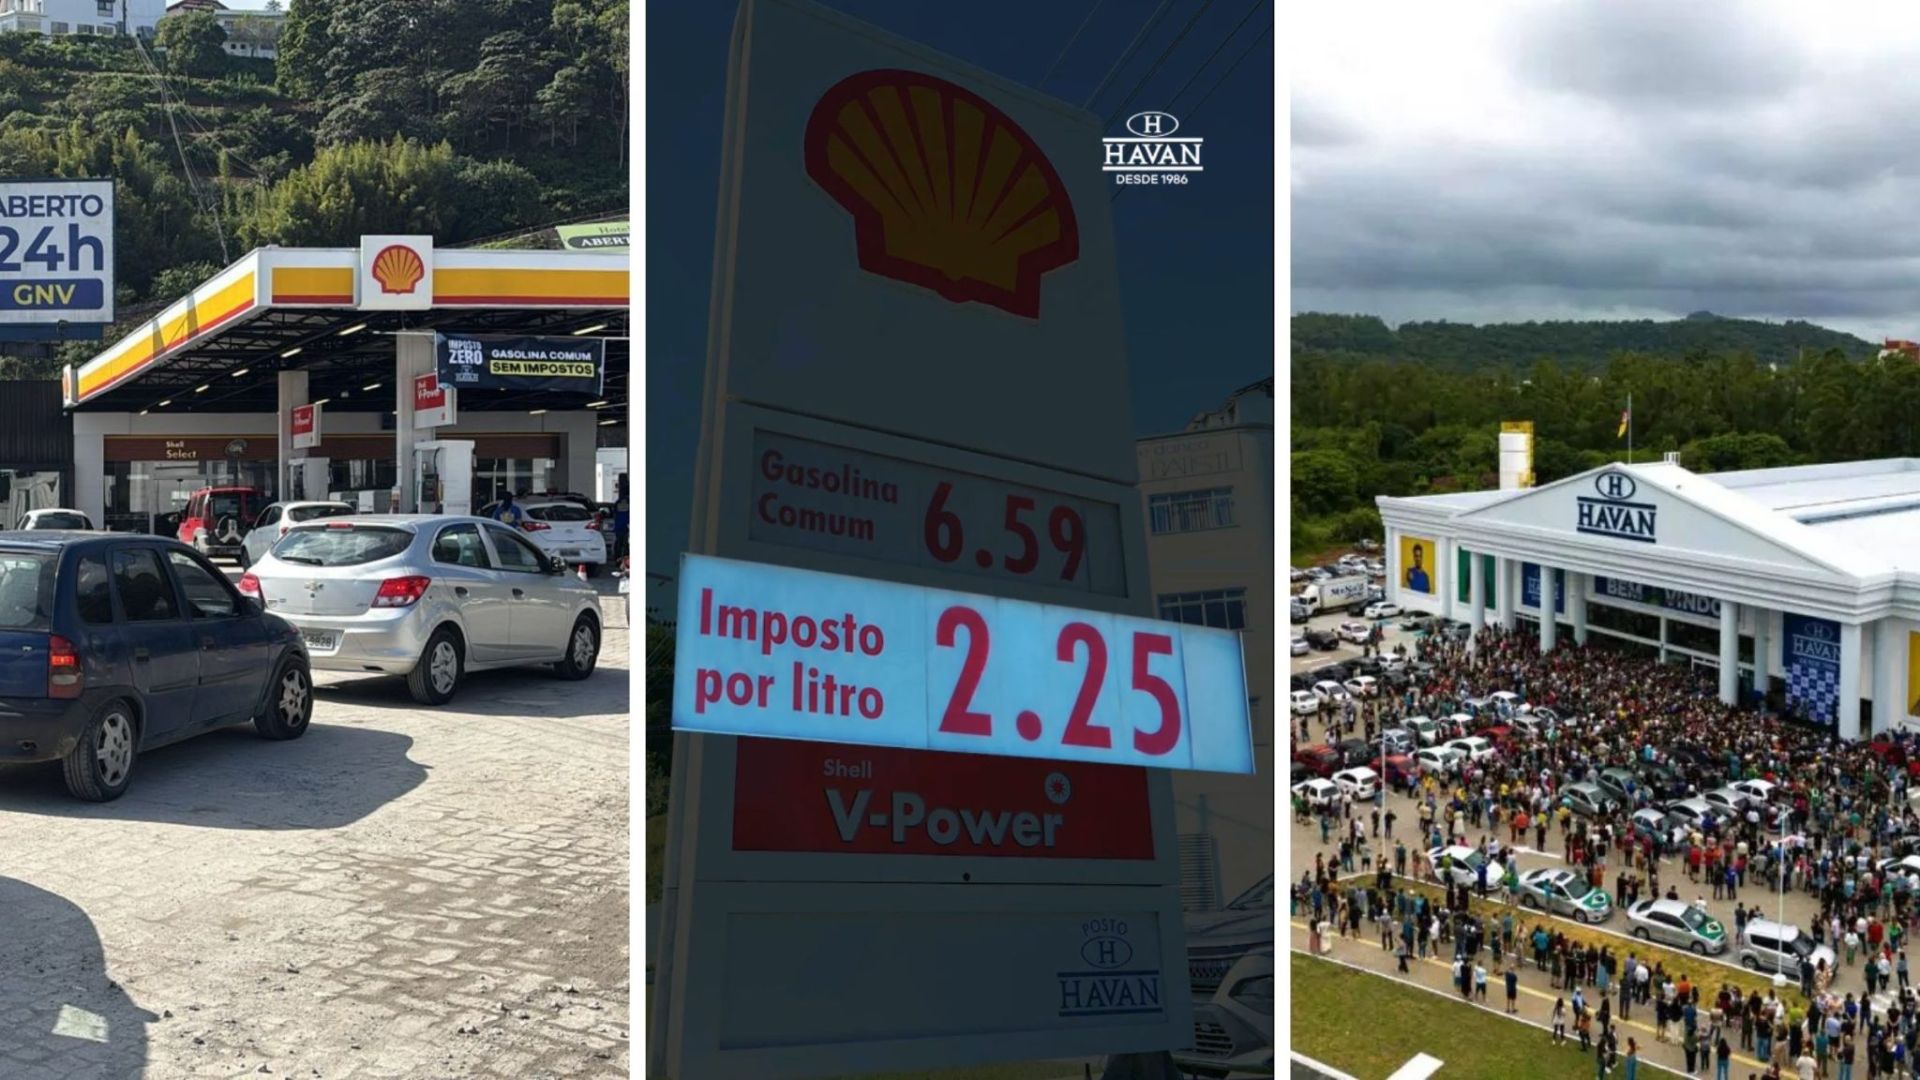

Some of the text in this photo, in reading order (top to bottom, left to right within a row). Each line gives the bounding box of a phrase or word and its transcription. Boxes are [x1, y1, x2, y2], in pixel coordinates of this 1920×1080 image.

[13, 284, 76, 305] GNV
[448, 339, 482, 350] IMPOSTO
[491, 349, 592, 361] GASOLINA COMUM
[449, 349, 483, 365] ZERO
[492, 362, 593, 375] SEM IMPOSTOS
[166, 449, 197, 459] Select
[1608, 475, 1623, 496] H
[757, 492, 876, 541] Comum
[761, 448, 1086, 582] Gasolina 6.59
[1577, 502, 1656, 536] HAVAN
[1606, 577, 1643, 600] BEM
[700, 587, 1183, 756] Imposto 2.25
[695, 661, 884, 720] por litro
[823, 759, 872, 779] Shell
[824, 787, 1064, 848] V-Power
[1081, 918, 1128, 937] POSTO
[1099, 940, 1116, 964] H
[1059, 977, 1160, 1009] HAVAN
